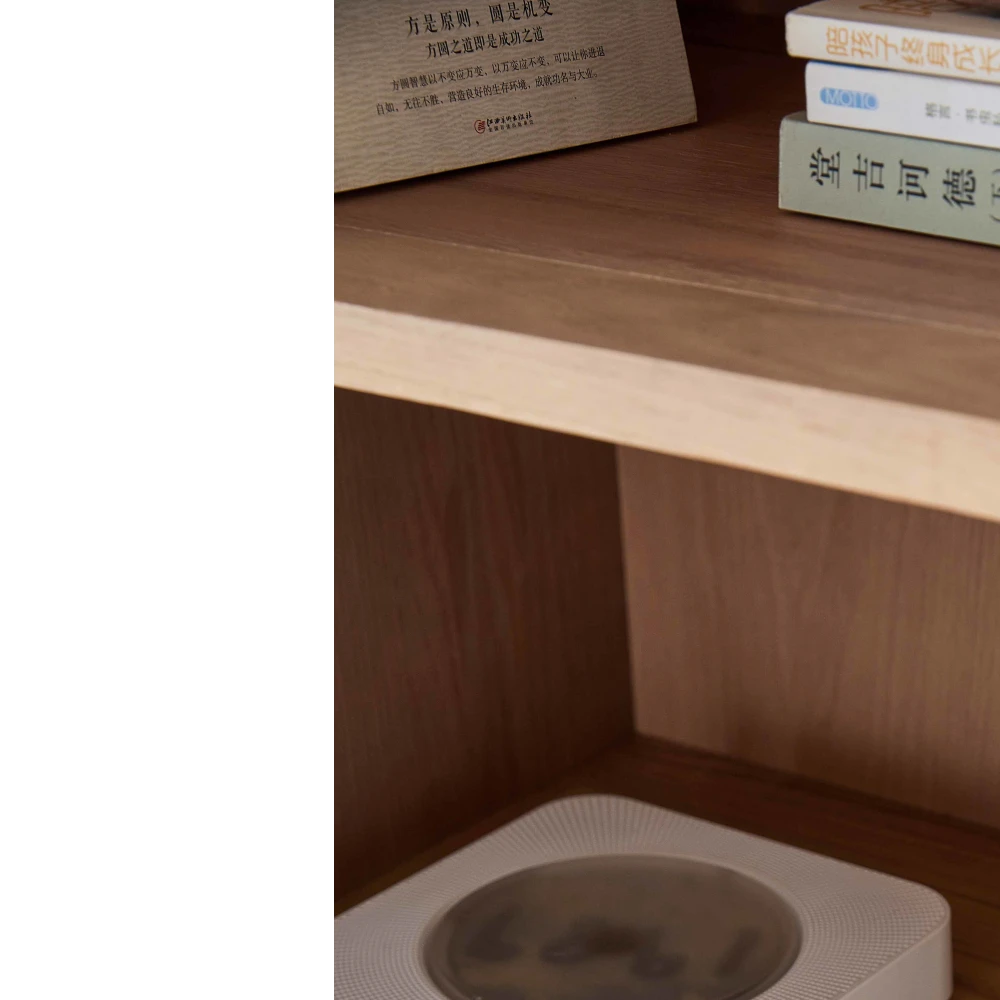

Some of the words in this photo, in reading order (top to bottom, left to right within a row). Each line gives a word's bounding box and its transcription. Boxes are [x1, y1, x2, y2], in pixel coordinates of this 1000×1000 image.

[404, 0, 554, 37] 方是原则，圆是机变
[426, 26, 545, 59] 方圆之道即是成功之道
